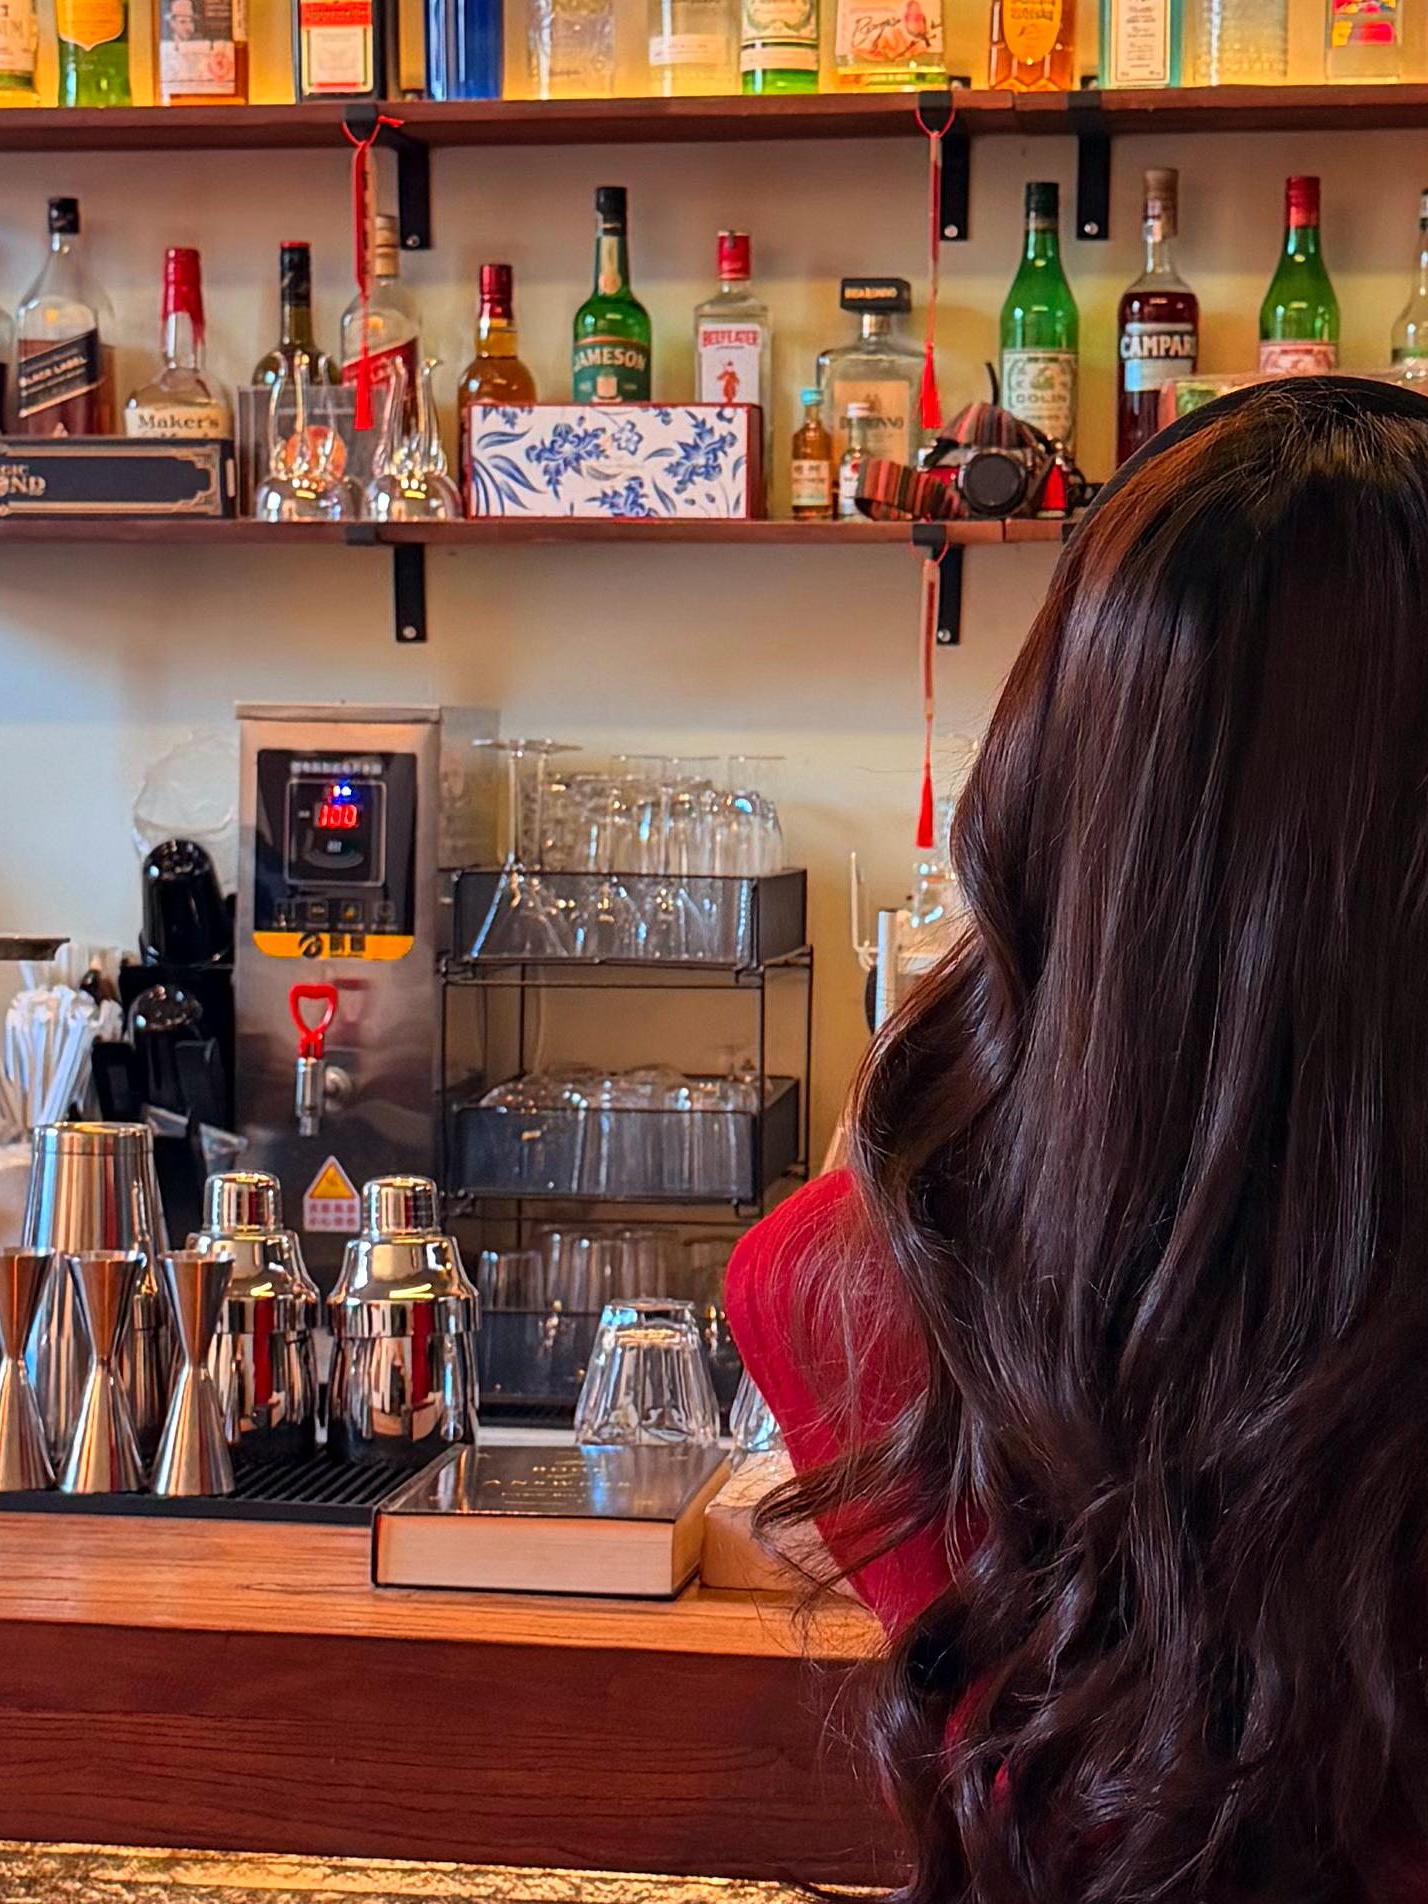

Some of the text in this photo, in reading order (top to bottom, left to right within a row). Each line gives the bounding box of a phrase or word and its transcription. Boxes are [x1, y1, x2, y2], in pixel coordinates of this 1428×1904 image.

[573, 347, 646, 373] JAMESON
[137, 414, 220, 431] Maker's
[317, 804, 358, 829] 100
